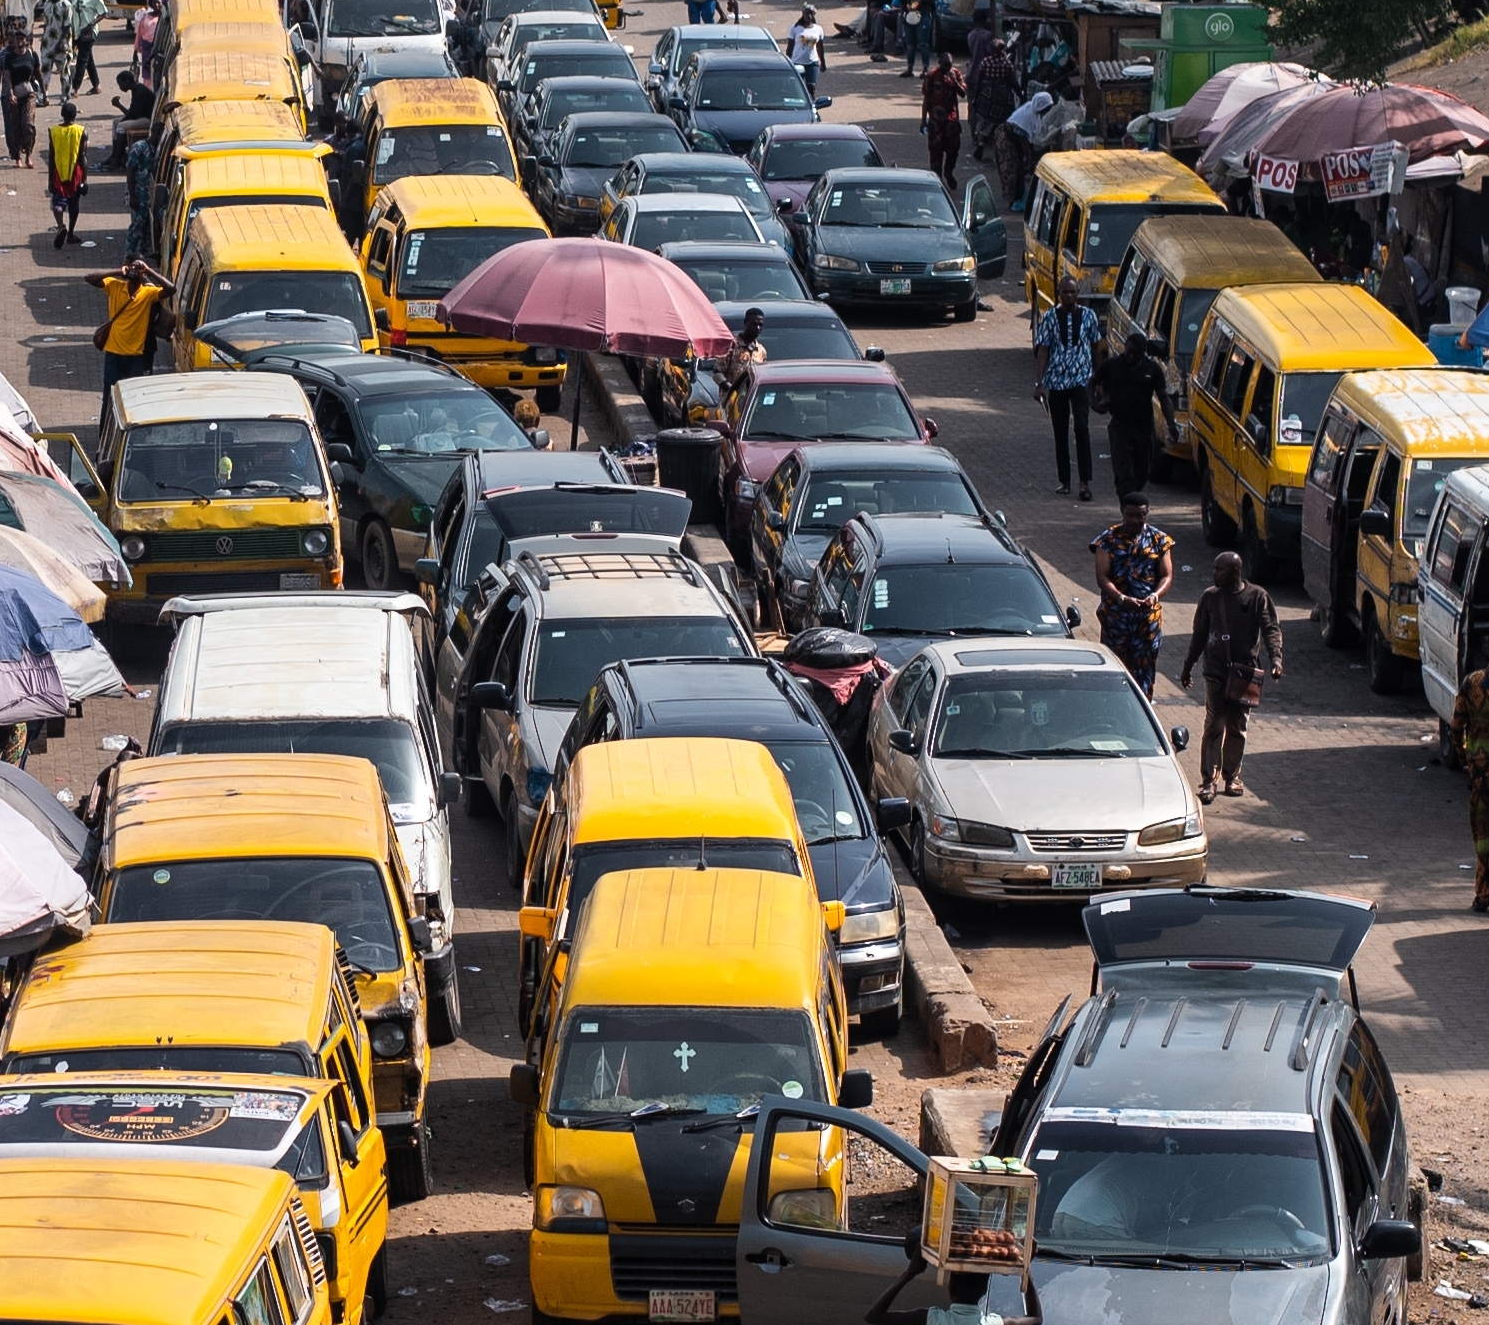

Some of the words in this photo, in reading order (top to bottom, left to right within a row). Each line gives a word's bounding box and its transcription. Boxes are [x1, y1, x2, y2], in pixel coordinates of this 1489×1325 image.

[1210, 20, 1230, 36] glo
[1256, 157, 1298, 190] POS
[1325, 150, 1363, 181] POS
